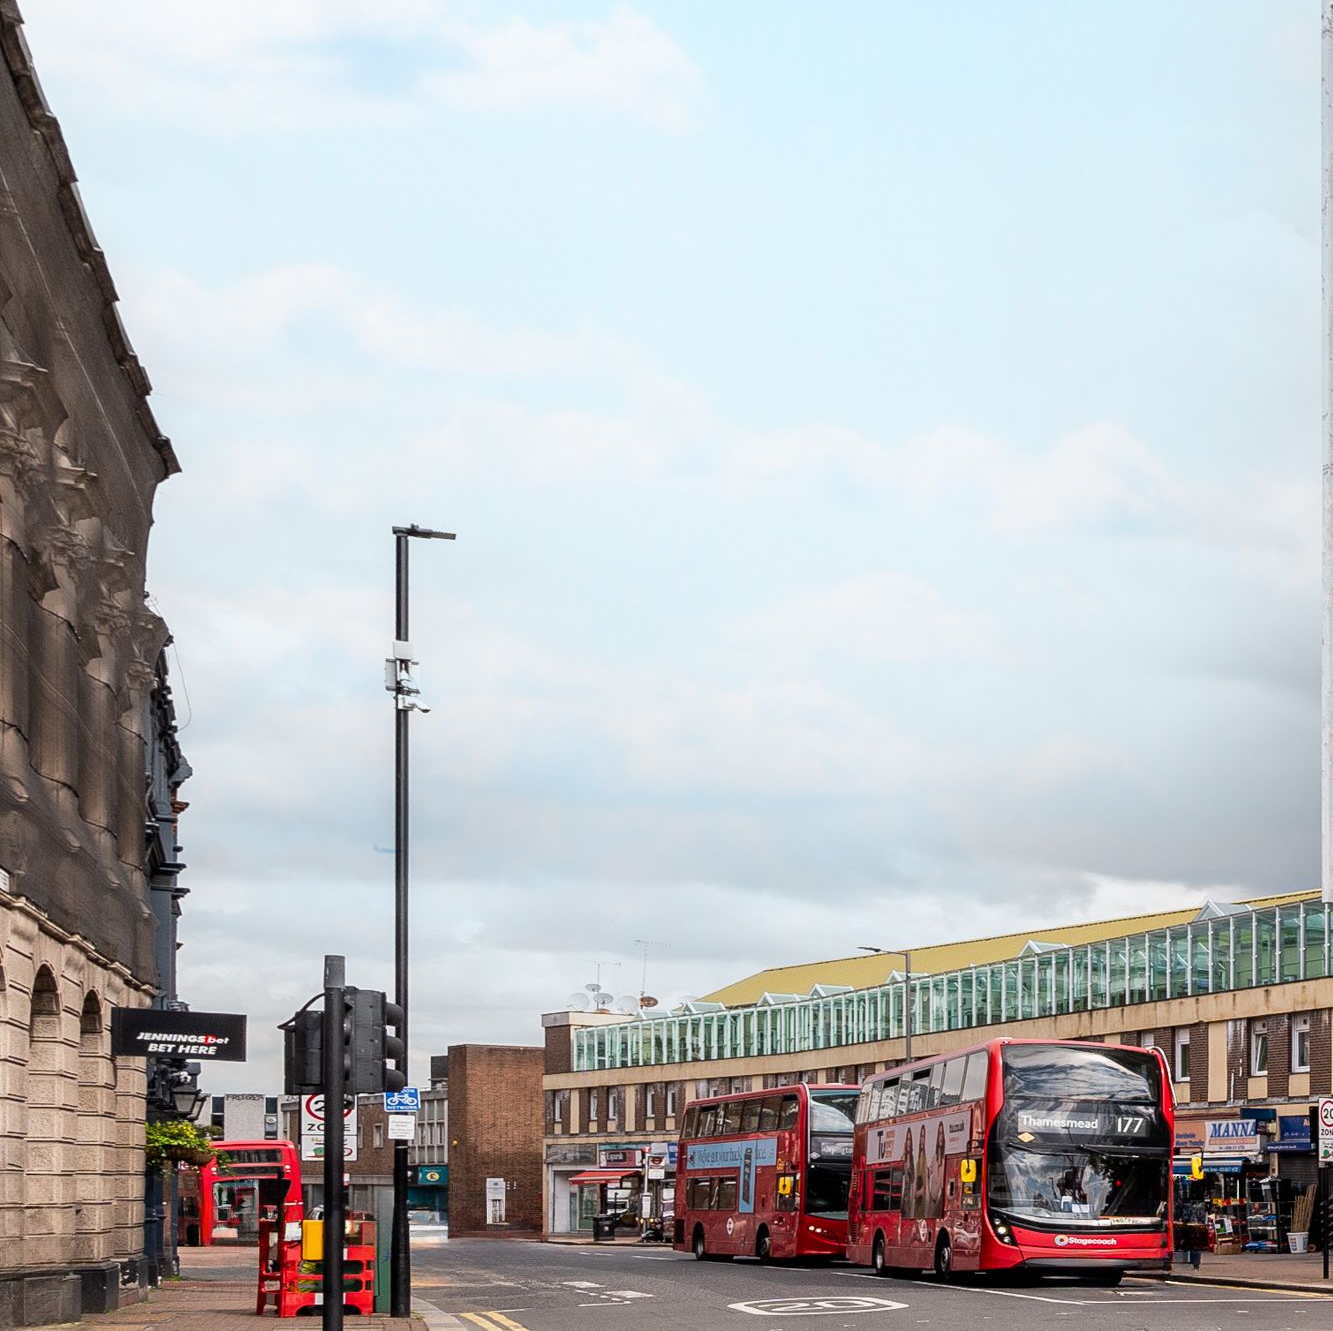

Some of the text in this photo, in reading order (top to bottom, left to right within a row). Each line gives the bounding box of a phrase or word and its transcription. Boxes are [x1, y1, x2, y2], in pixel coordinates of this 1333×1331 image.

[148, 1043, 217, 1055] BET HERE
[307, 1123, 350, 1131] ZOE
[1021, 1115, 1144, 1133] Thamesmead 177
[1068, 1236, 1117, 1245] Stagecoach
